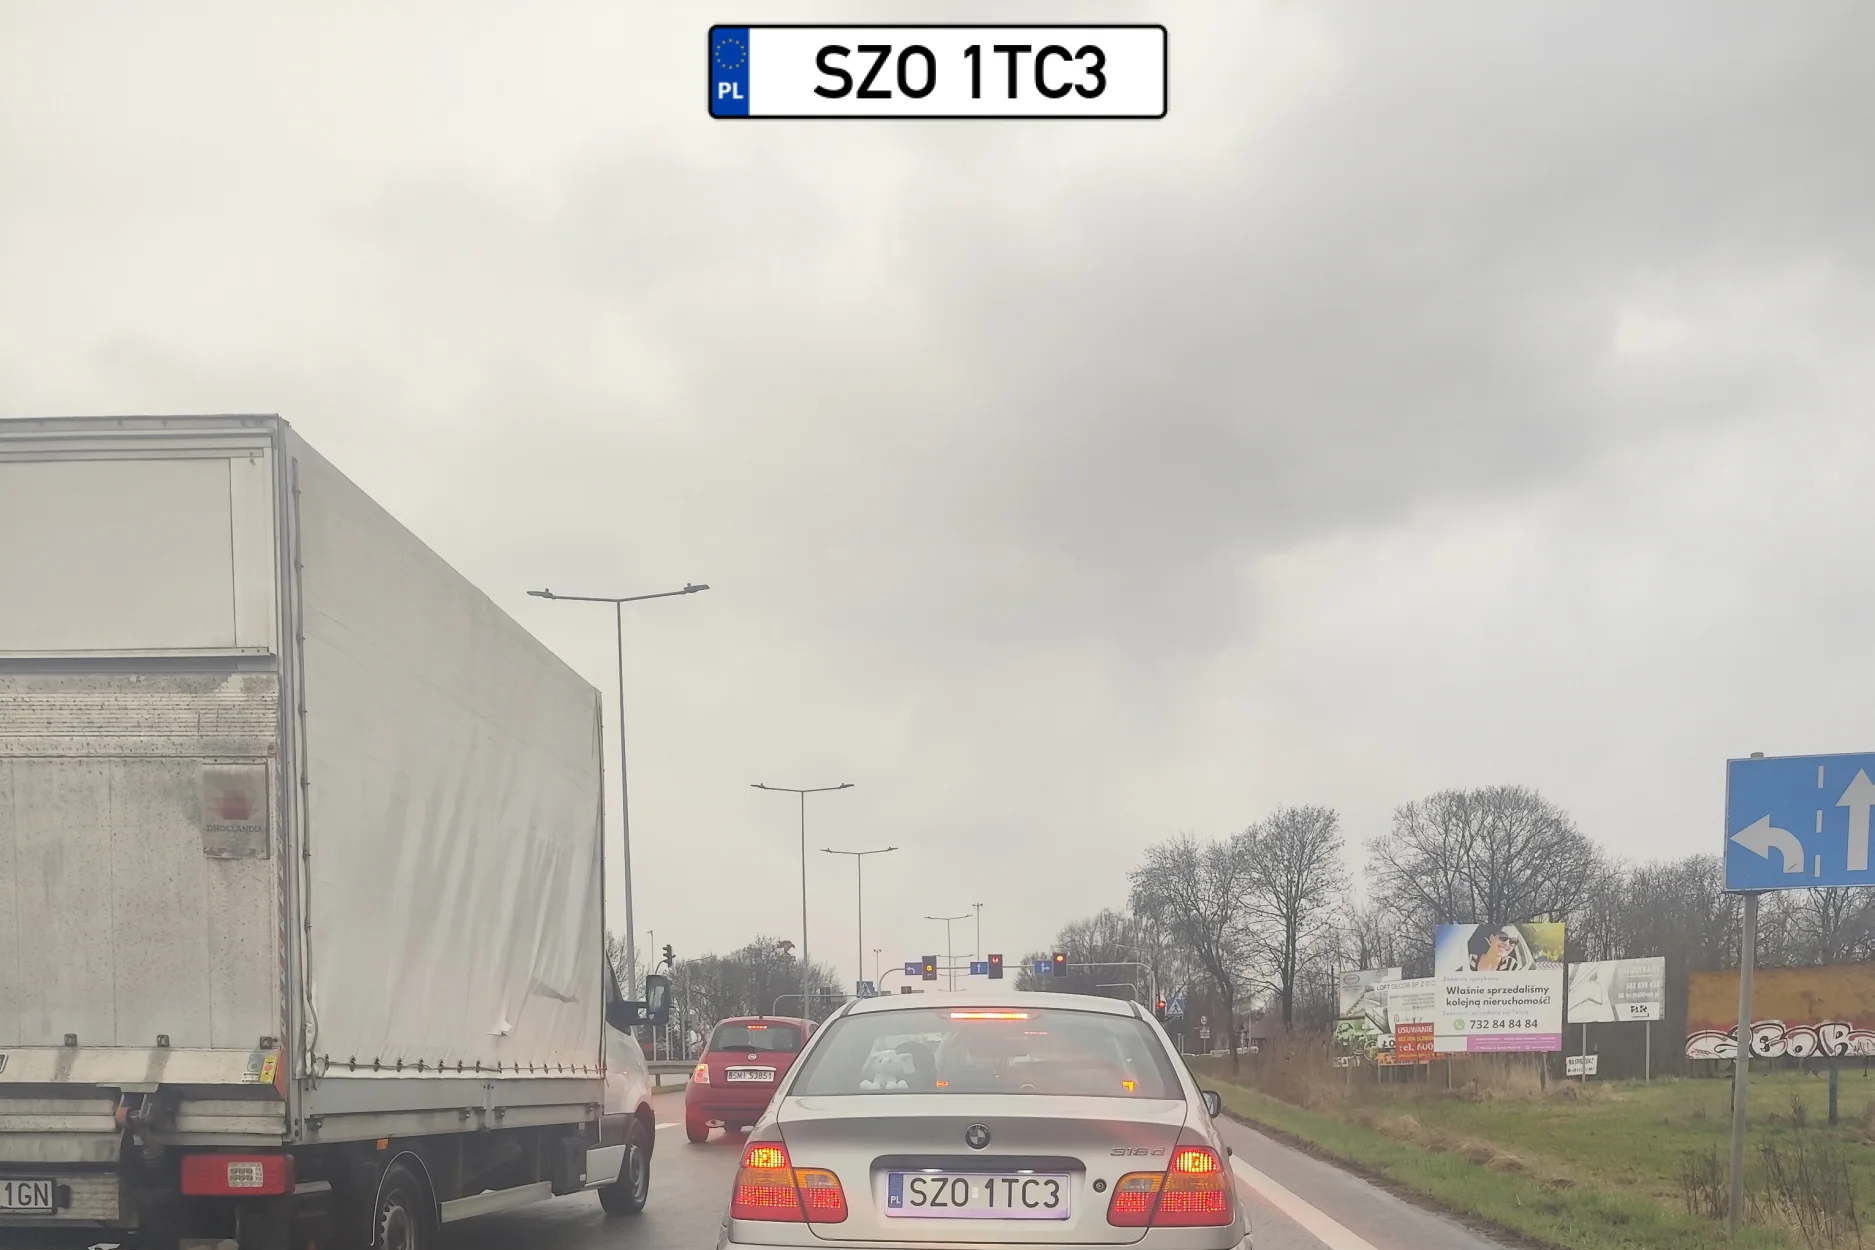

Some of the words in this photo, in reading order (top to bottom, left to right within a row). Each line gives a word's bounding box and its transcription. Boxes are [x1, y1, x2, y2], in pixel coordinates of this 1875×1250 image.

[205, 824, 264, 833] DHOLLANDIA
[1391, 982, 1410, 990] DECOR
[1446, 985, 1485, 995] Właśnie
[1487, 984, 1550, 996] sprzedaliśmy
[1446, 997, 1481, 1008] kolejną
[1483, 996, 1551, 1006] nieruchomość!
[1469, 1019, 1490, 1029] 732
[1492, 1019, 1506, 1029] 84
[1508, 1019, 1522, 1029] 84
[1524, 1019, 1538, 1028] 84
[1397, 1025, 1433, 1034] USUWANIE
[1398, 1042, 1415, 1052] tel.
[1416, 1042, 1434, 1051] 600
[732, 1071, 746, 1080] SMI
[749, 1071, 772, 1080] 53851
[4, 1182, 49, 1206] 1GN
[909, 1177, 970, 1207] SZO
[984, 1178, 1060, 1208] 1TC3
[890, 1195, 901, 1204] PL
